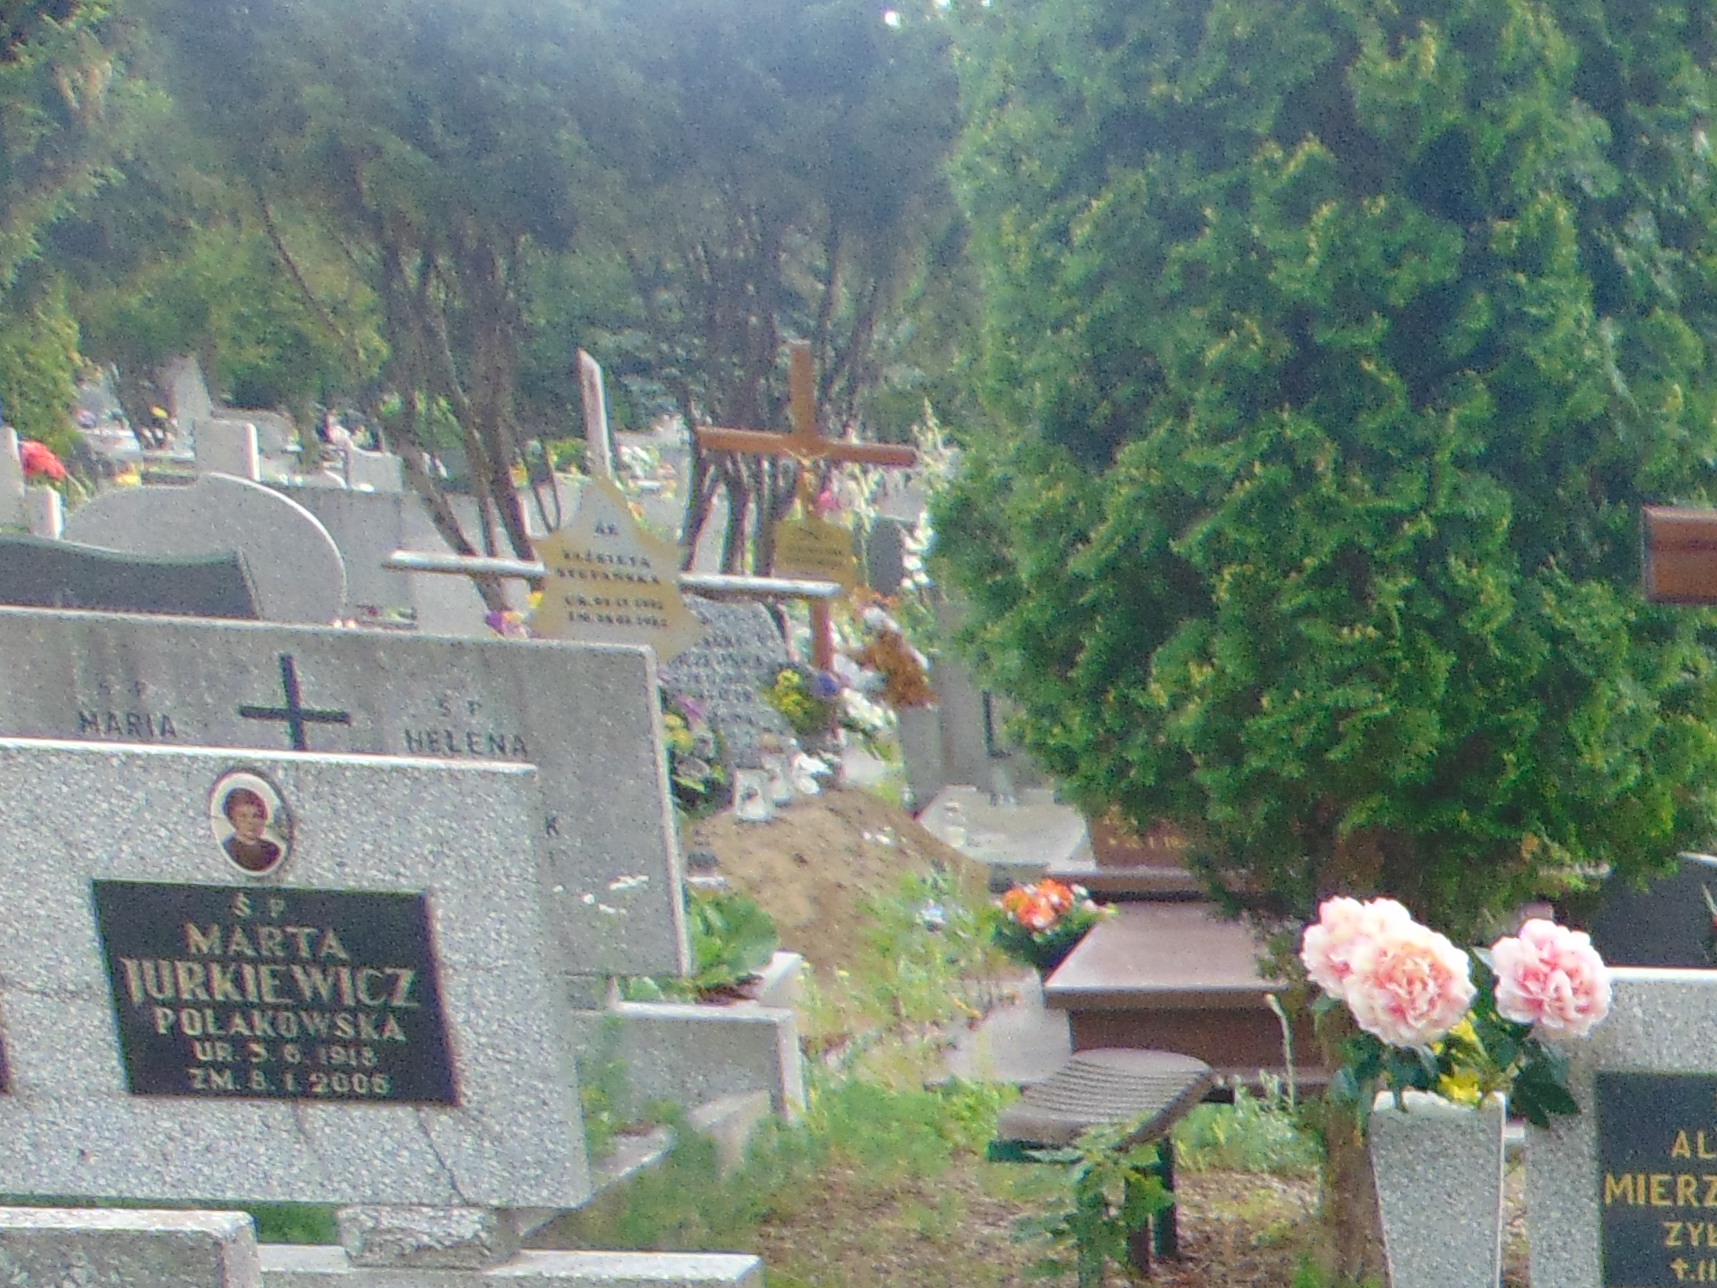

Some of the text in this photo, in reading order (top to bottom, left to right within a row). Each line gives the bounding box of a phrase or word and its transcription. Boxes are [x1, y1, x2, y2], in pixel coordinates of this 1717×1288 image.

[78, 711, 179, 740] MARIA
[405, 729, 529, 757] HELENA
[269, 898, 286, 919] P
[182, 922, 350, 960] MARTA
[119, 957, 420, 1007] JURKIEWICZ
[152, 1006, 406, 1042] POLAKOWSKA
